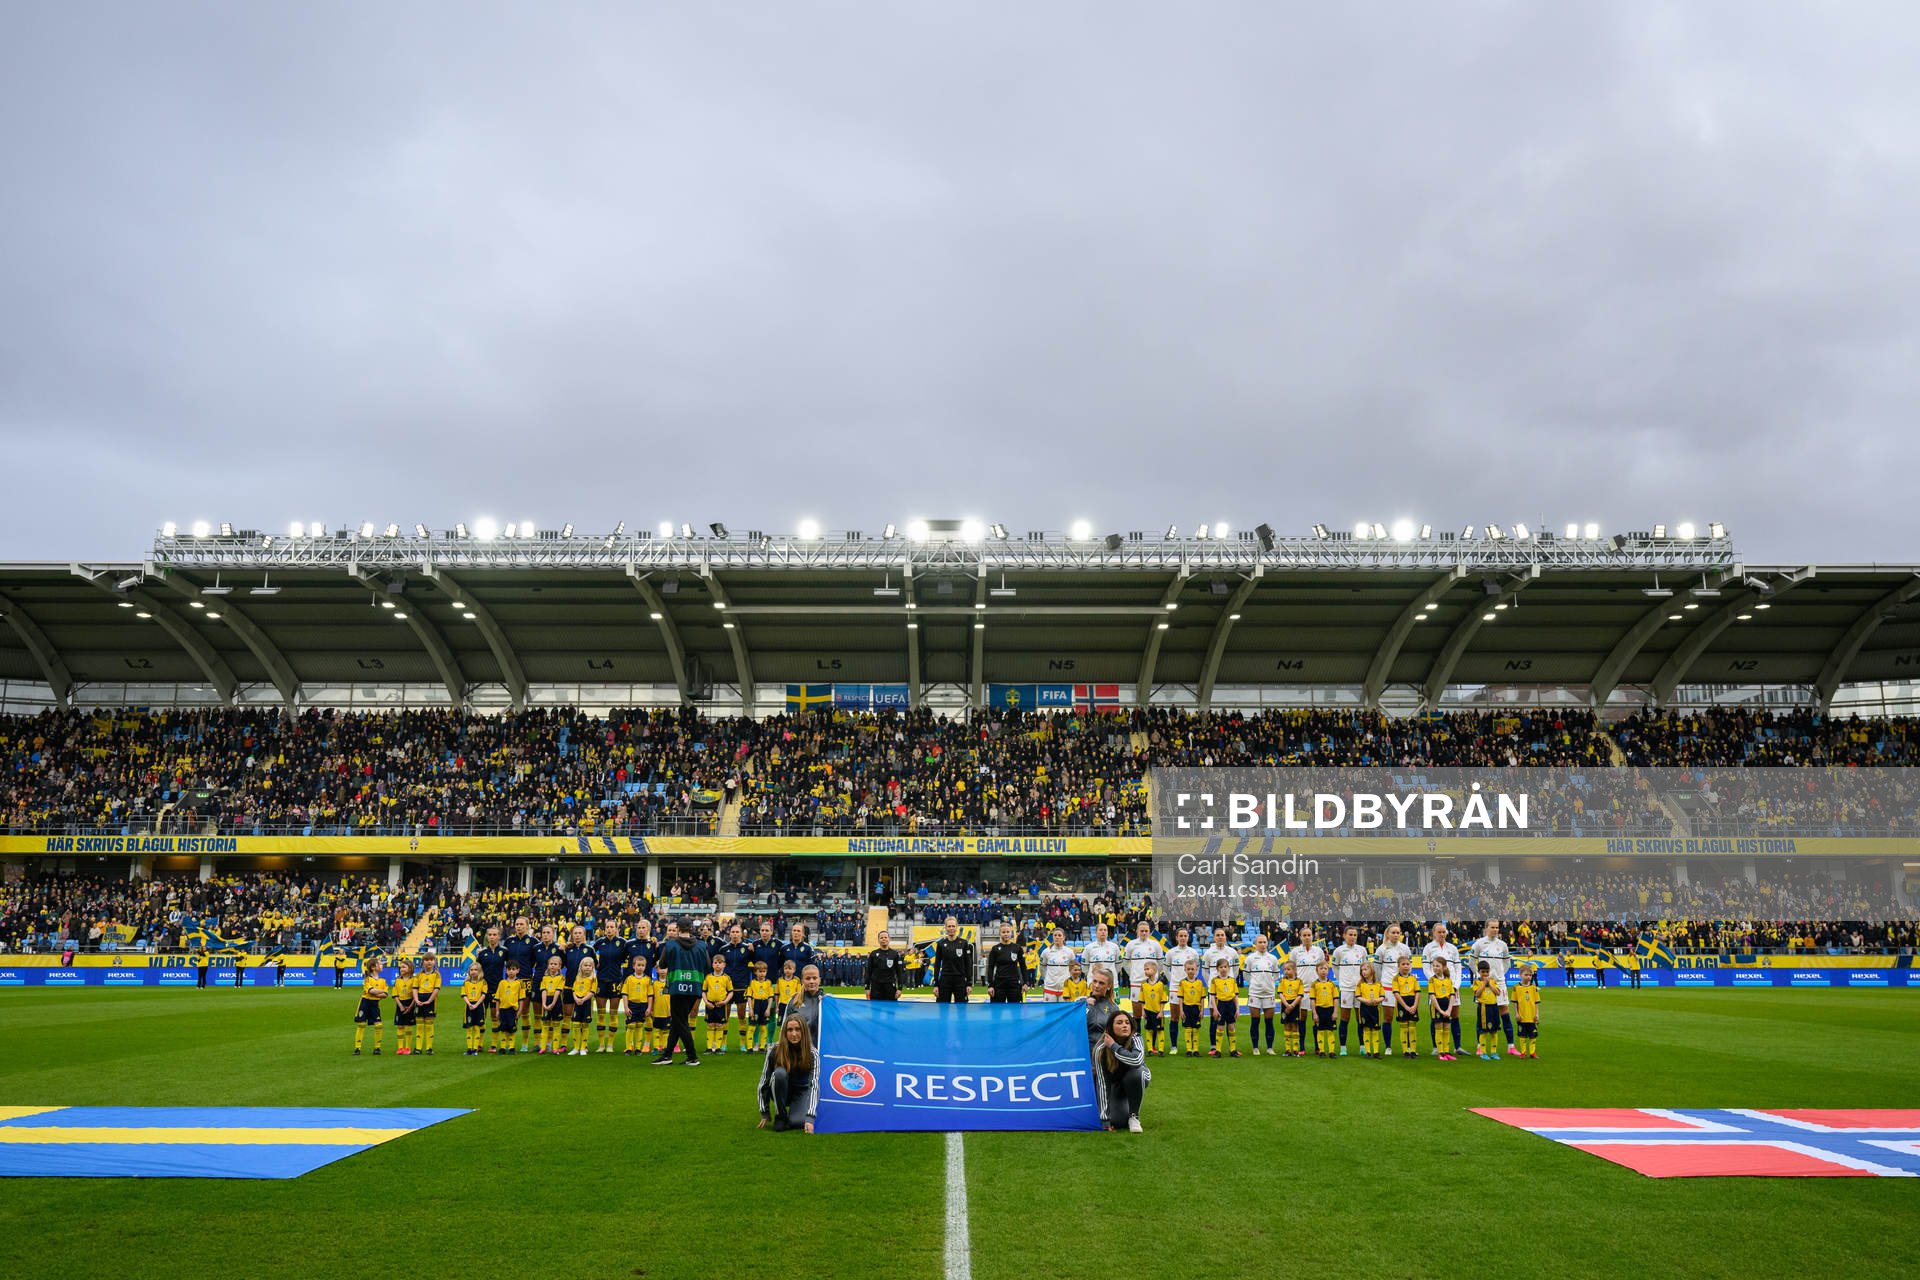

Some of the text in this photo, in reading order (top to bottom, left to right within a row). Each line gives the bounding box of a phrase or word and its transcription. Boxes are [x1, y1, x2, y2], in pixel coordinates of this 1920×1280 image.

[124, 658, 154, 669] L2
[356, 659, 385, 669] L3
[587, 659, 615, 669] L4
[817, 659, 842, 669] L5
[1049, 659, 1075, 670] N5
[1277, 660, 1304, 670] N4
[1504, 660, 1532, 670] N3
[1728, 660, 1758, 670] N2
[875, 694, 906, 704] UEFA
[1042, 690, 1067, 700] FIFA
[47, 837, 237, 852] HÄR SKRIVS BLÅGUL HISTORIA
[848, 838, 965, 853] NATIONALARENAN
[976, 838, 1021, 853] GAMLA
[1024, 838, 1067, 853] ULLEVI
[1606, 839, 1634, 853] HÄR
[1636, 839, 1683, 853] SKRIVS
[1737, 839, 1797, 853] HISTORIA
[839, 1065, 867, 1076] UEFA
[895, 1070, 1086, 1102] RESPECT
